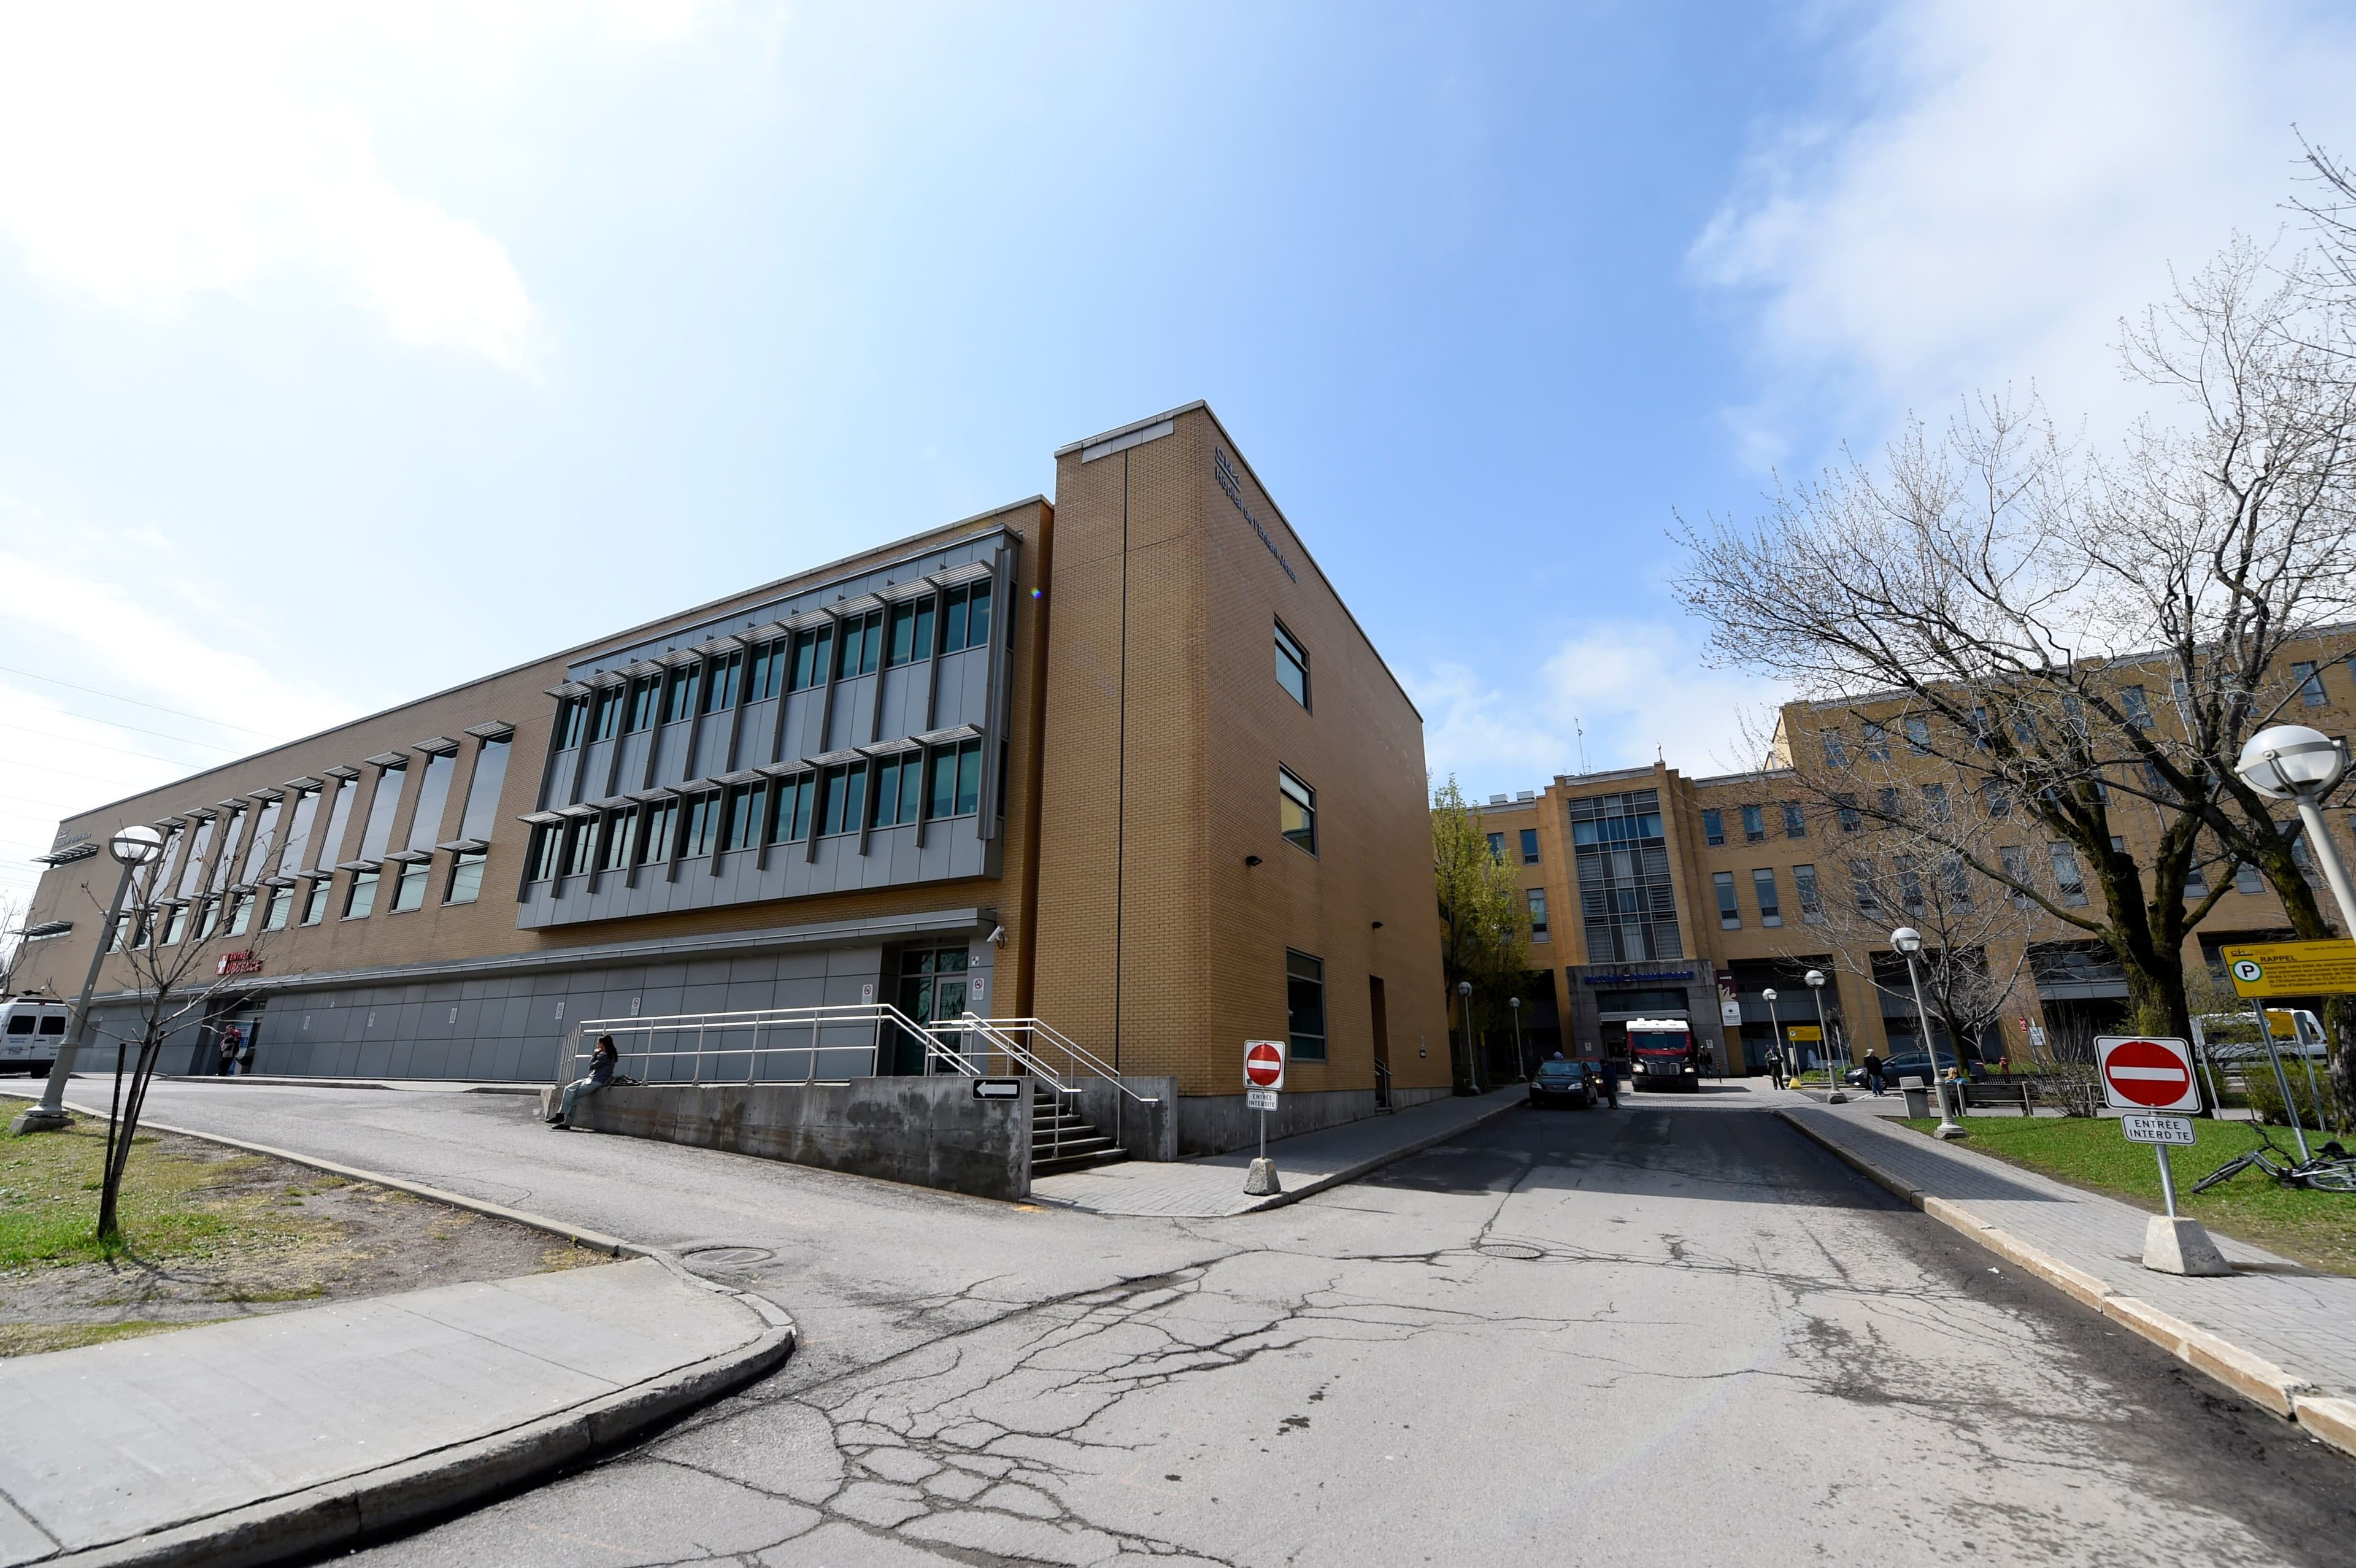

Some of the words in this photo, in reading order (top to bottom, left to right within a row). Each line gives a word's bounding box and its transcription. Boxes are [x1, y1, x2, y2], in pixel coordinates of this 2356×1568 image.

[1215, 466, 1242, 511] Hôpital
[1243, 507, 1253, 525] de
[2241, 965, 2255, 977] P
[2135, 1119, 2181, 1129] ENTRÉE
[2130, 1129, 2191, 1140] INTERDTE
